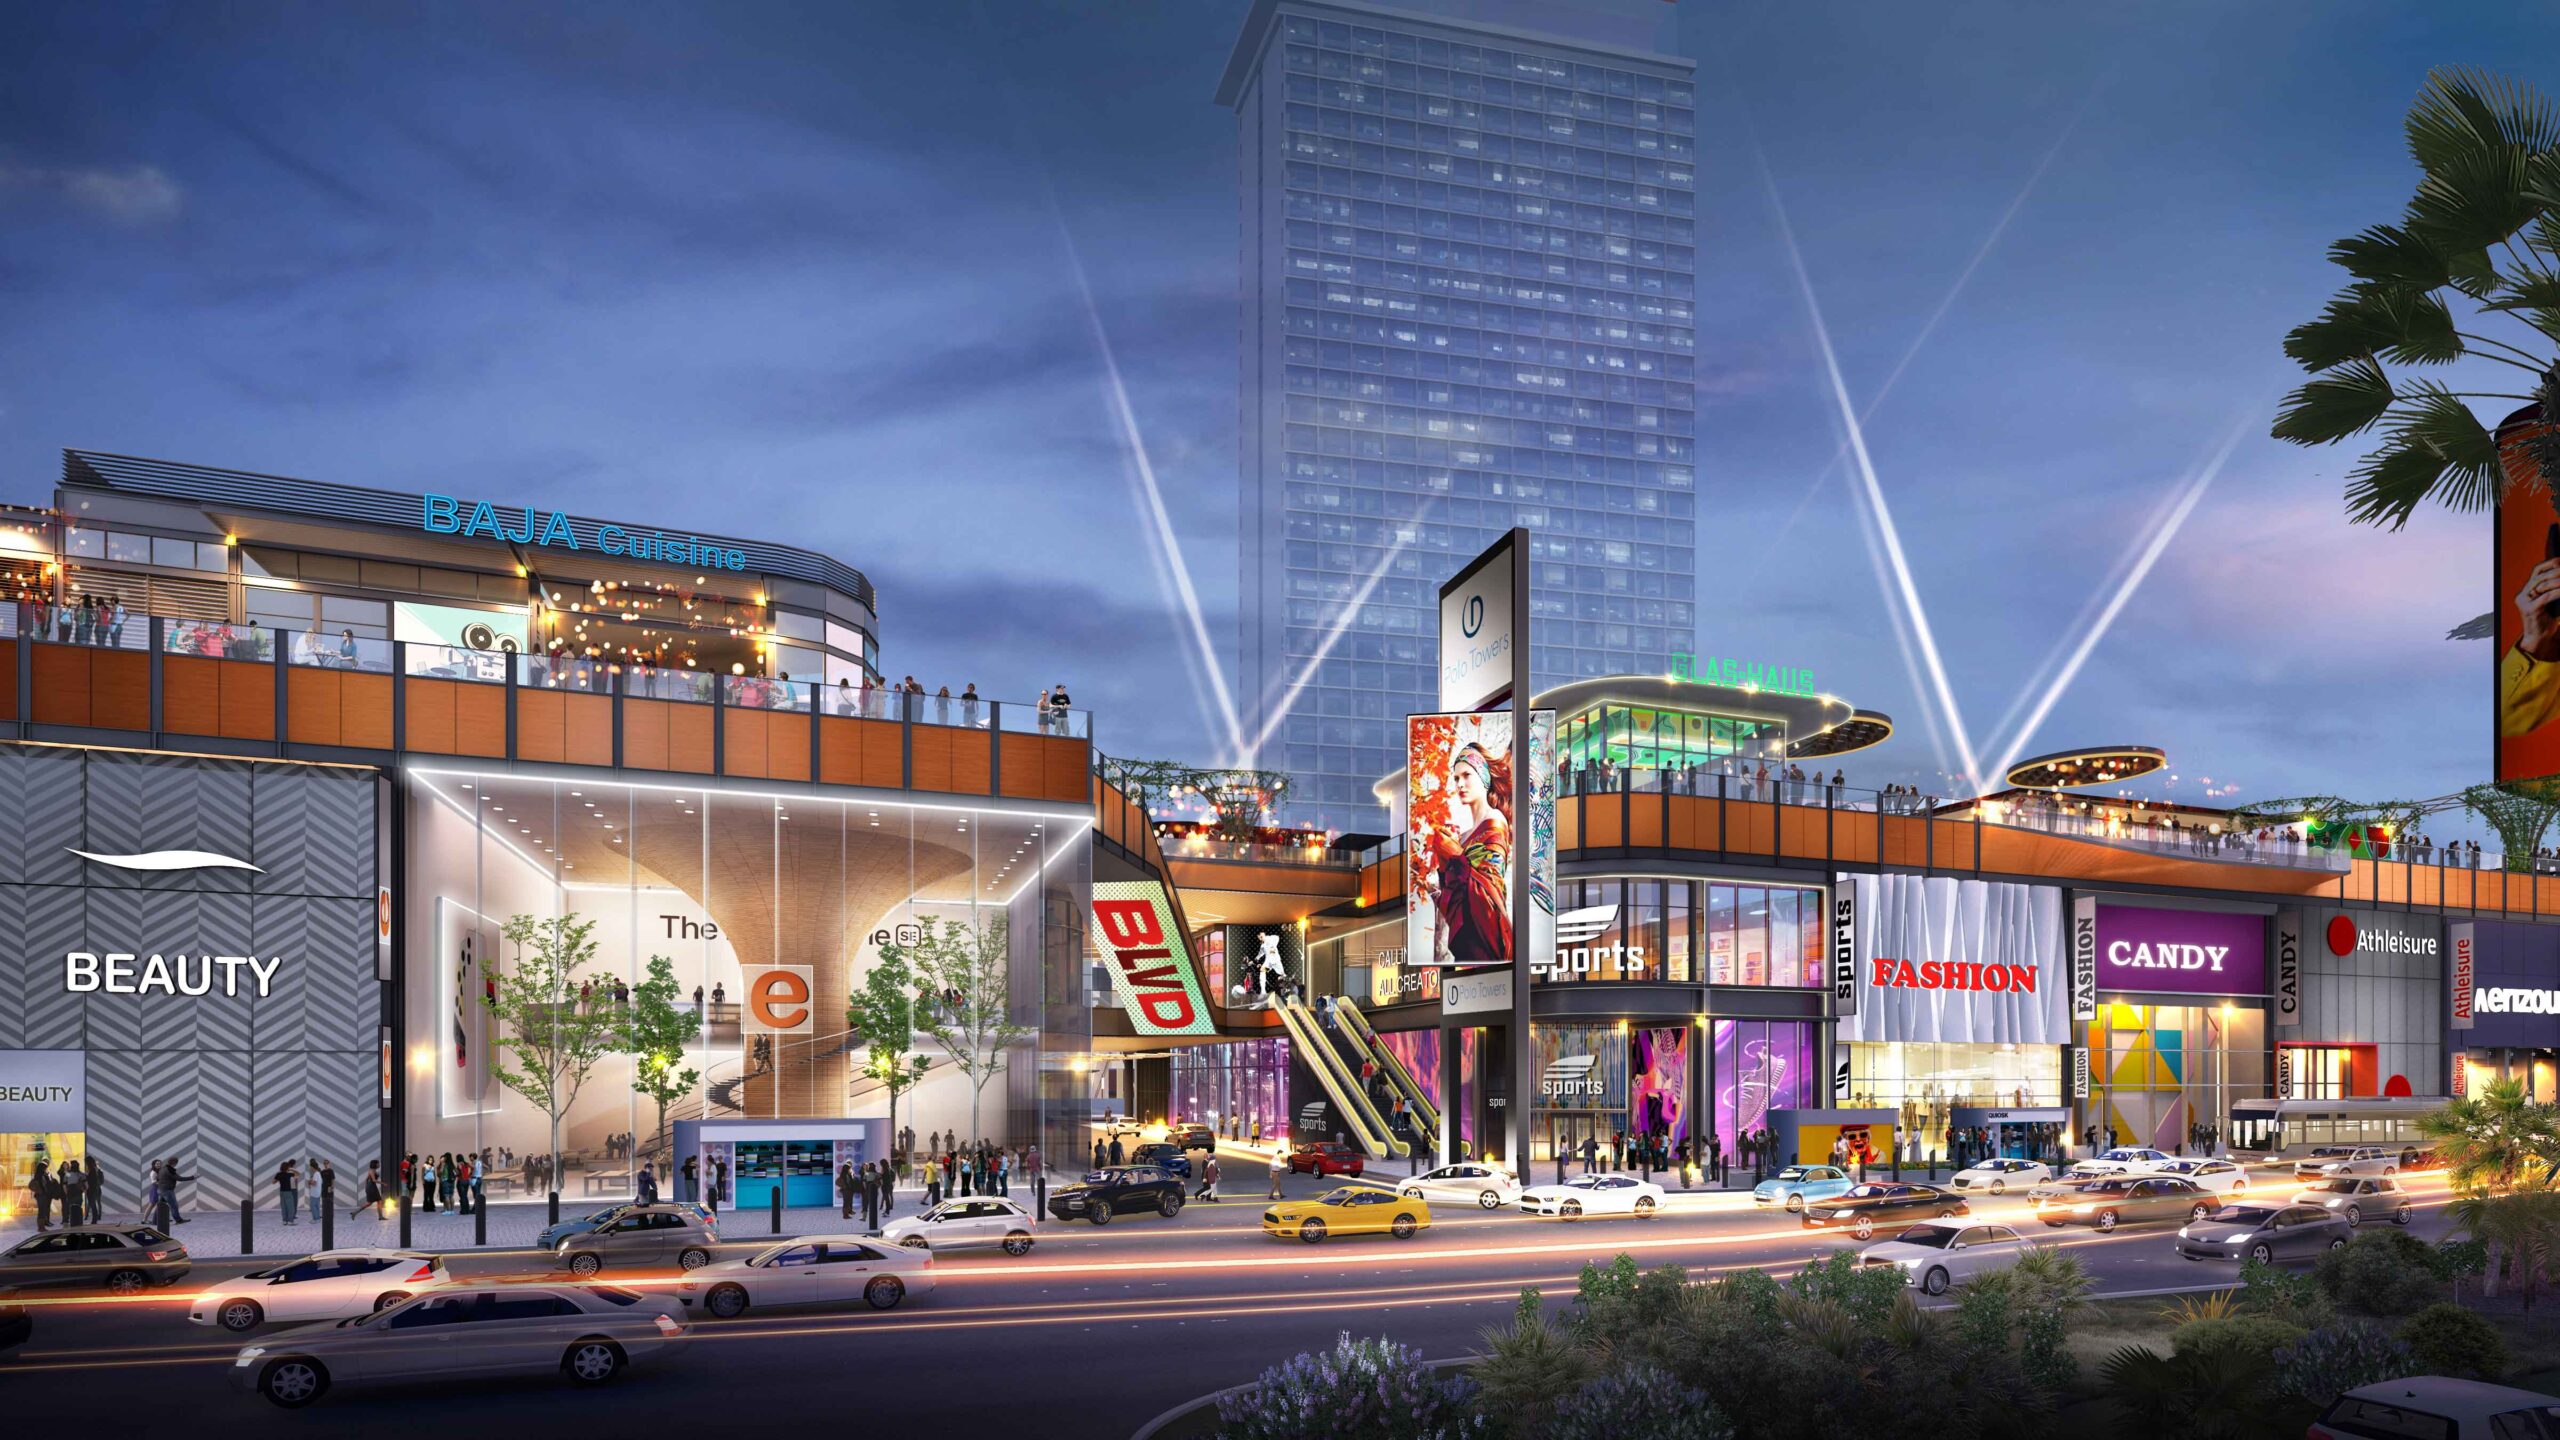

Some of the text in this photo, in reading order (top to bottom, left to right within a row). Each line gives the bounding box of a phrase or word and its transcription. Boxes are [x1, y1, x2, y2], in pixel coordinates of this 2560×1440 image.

[424, 493, 746, 571] BAJA Cuisine
[1444, 633, 1510, 683] Polo Towers
[659, 915, 718, 940] The
[900, 930, 917, 942] SE
[1836, 899, 1854, 999] sports
[2356, 929, 2437, 955] Athleisure
[66, 952, 281, 997] BEAUTY
[1092, 900, 1196, 1029] BLVD
[1872, 958, 2038, 993] FASHION
[2078, 918, 2093, 1013] FASHION
[2109, 941, 2229, 972] CANDY
[2281, 931, 2296, 1014] CANDY
[751, 970, 810, 1028] e
[1478, 982, 1506, 998] Towers
[2454, 939, 2471, 1019] Athleisure
[1543, 1078, 1604, 1099] sports
[2076, 1051, 2087, 1096] FASHION
[2280, 1054, 2290, 1095] CANDY
[2453, 1055, 2465, 1095] Athleisure
[1299, 1118, 1327, 1132] sports
